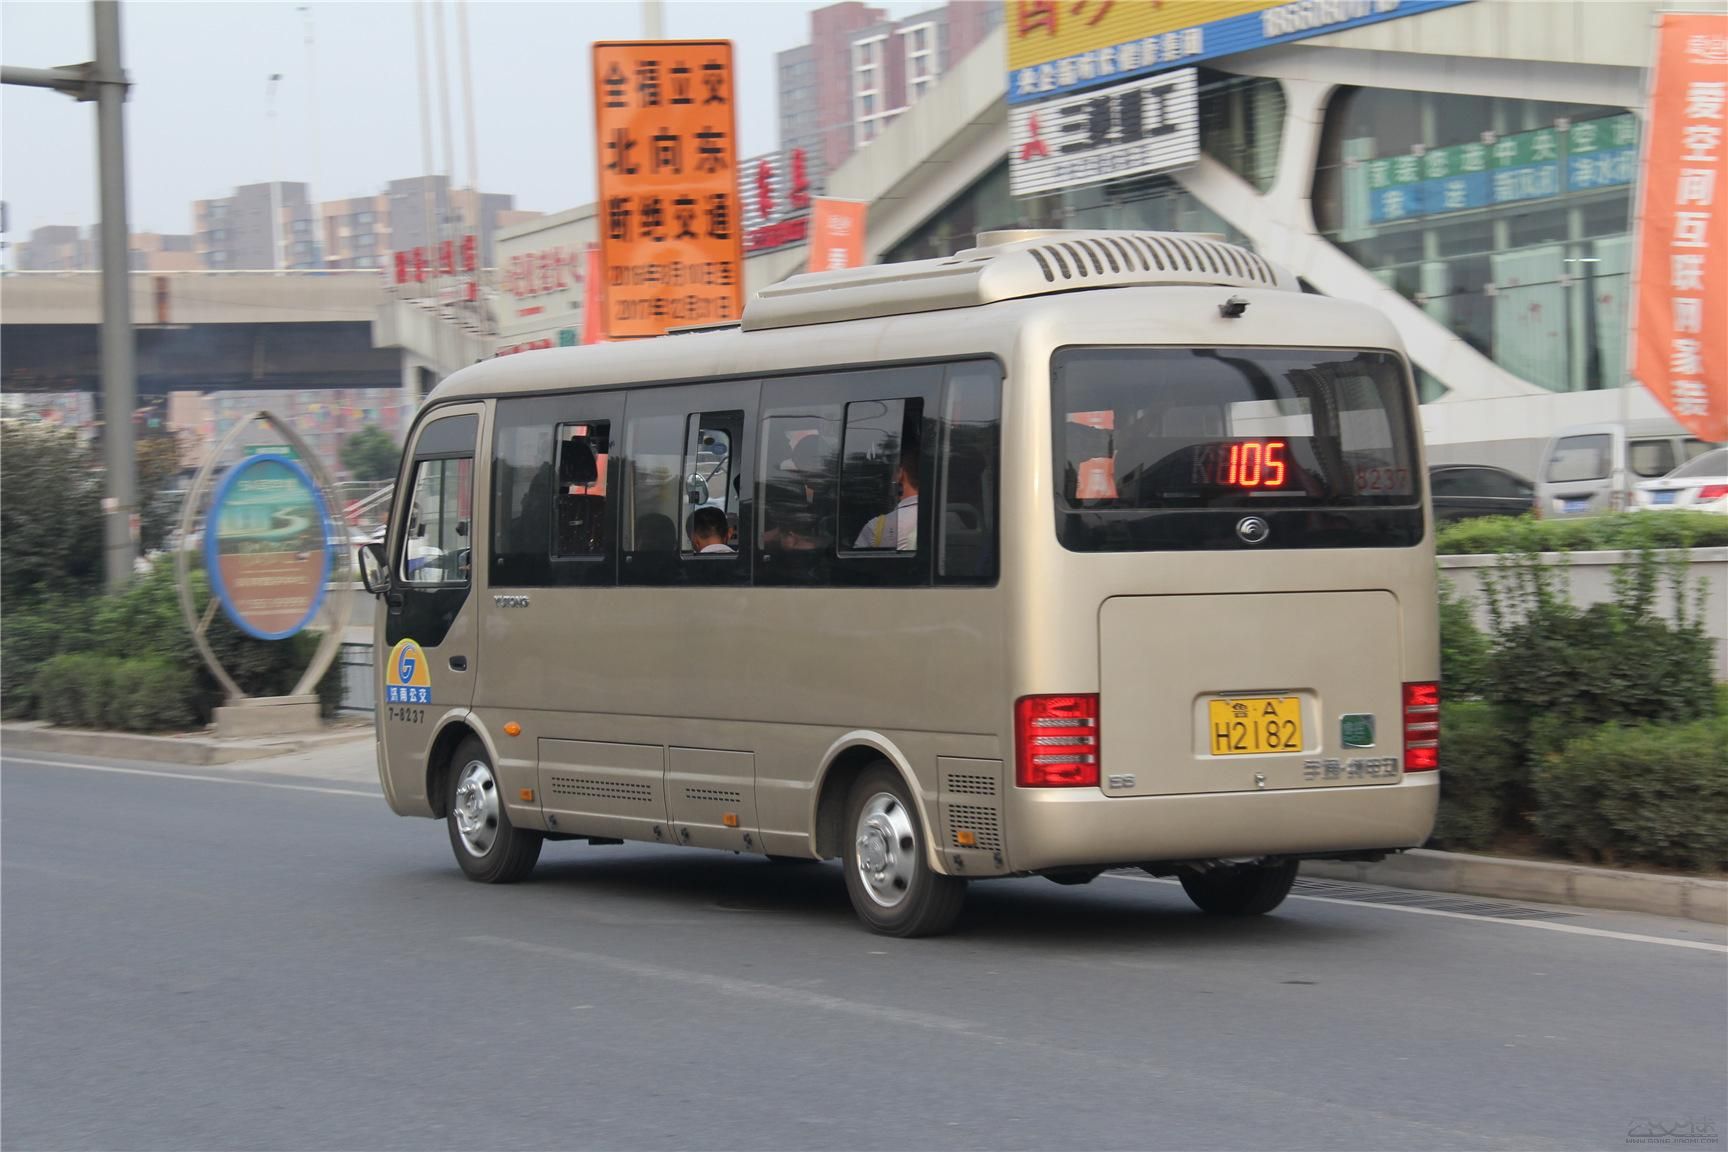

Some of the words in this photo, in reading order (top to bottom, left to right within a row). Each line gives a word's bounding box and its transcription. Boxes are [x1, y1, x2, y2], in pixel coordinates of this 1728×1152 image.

[602, 60, 726, 108] 全福立交
[606, 126, 729, 175] 北向东
[608, 193, 730, 243] 断绝交通
[1670, 82, 1725, 417] 爱空间互联网家装
[494, 594, 529, 608] YUTONG
[389, 687, 427, 703] 济南公交
[388, 707, 425, 724] 7-8237
[1215, 719, 1298, 751] H2182
